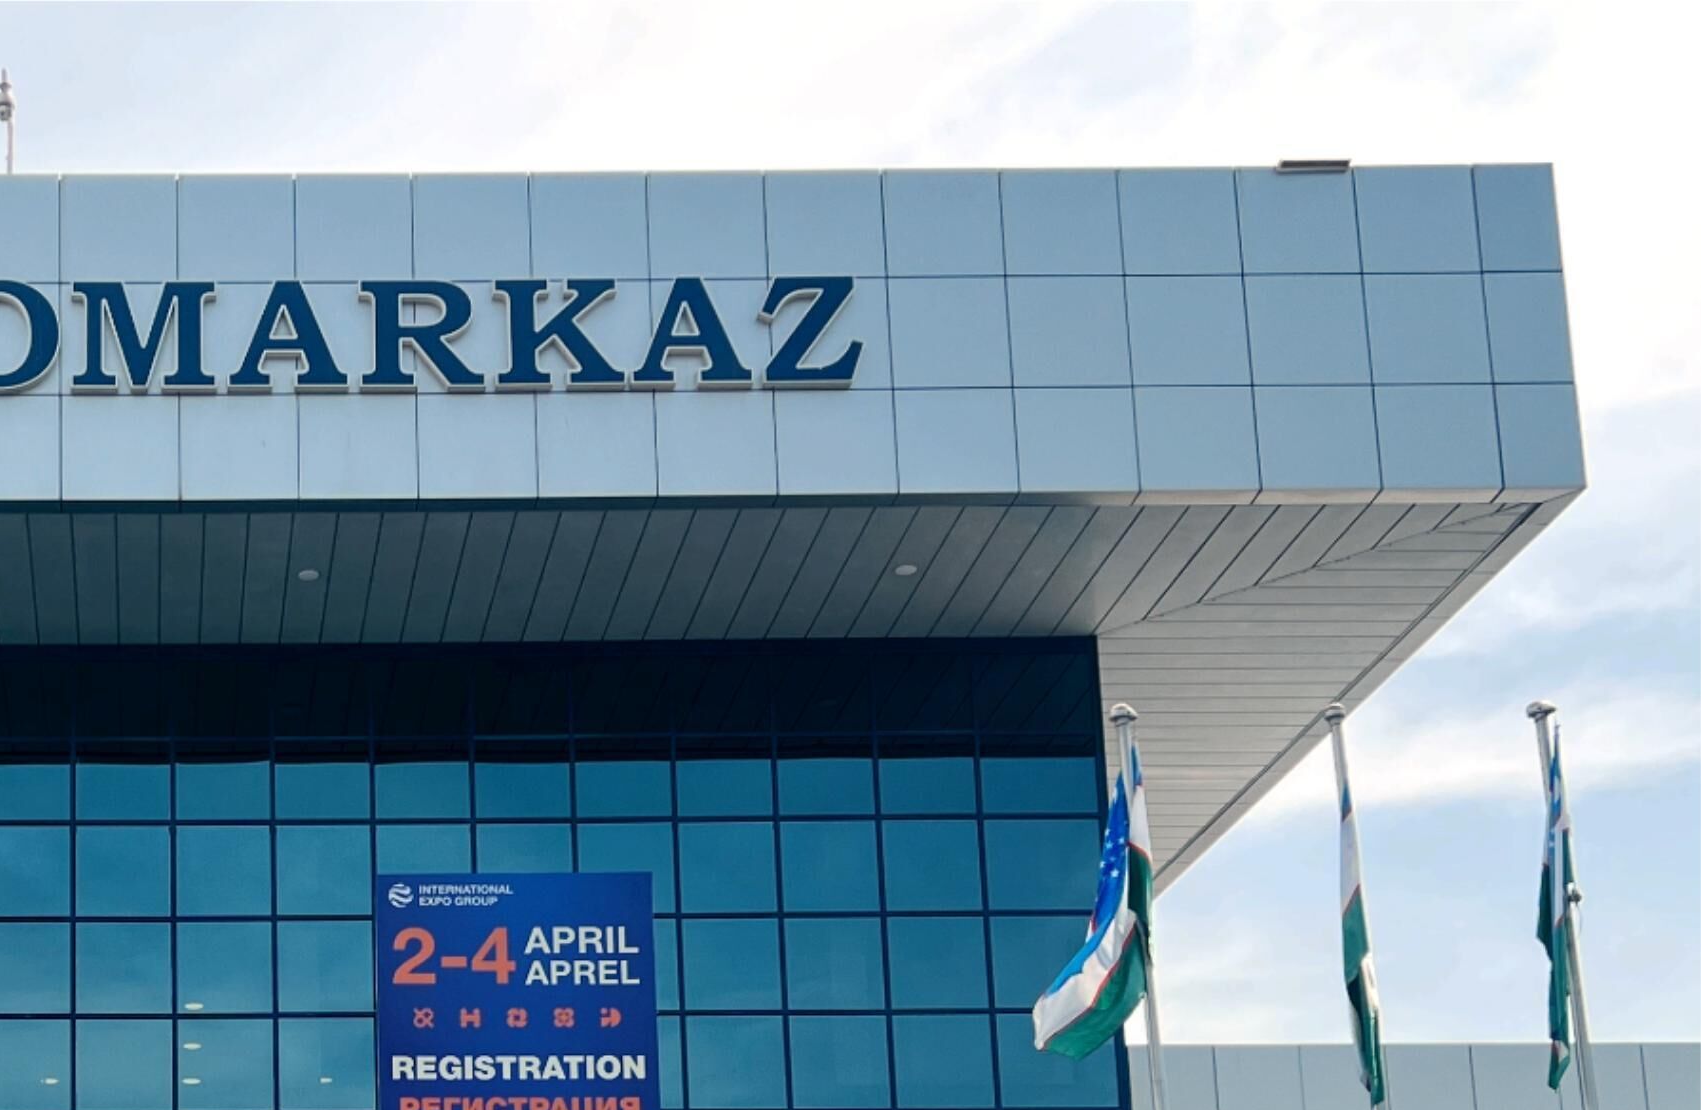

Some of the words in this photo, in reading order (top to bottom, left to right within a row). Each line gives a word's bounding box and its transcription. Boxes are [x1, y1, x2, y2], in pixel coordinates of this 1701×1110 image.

[418, 884, 514, 895] INTERNATIONAL
[418, 896, 452, 906] EXPO
[454, 896, 499, 906] GROUP
[524, 925, 640, 954] APRIL
[392, 926, 517, 985] 2-4
[525, 959, 641, 985] APREL
[391, 1054, 647, 1081] REGISTRATION
